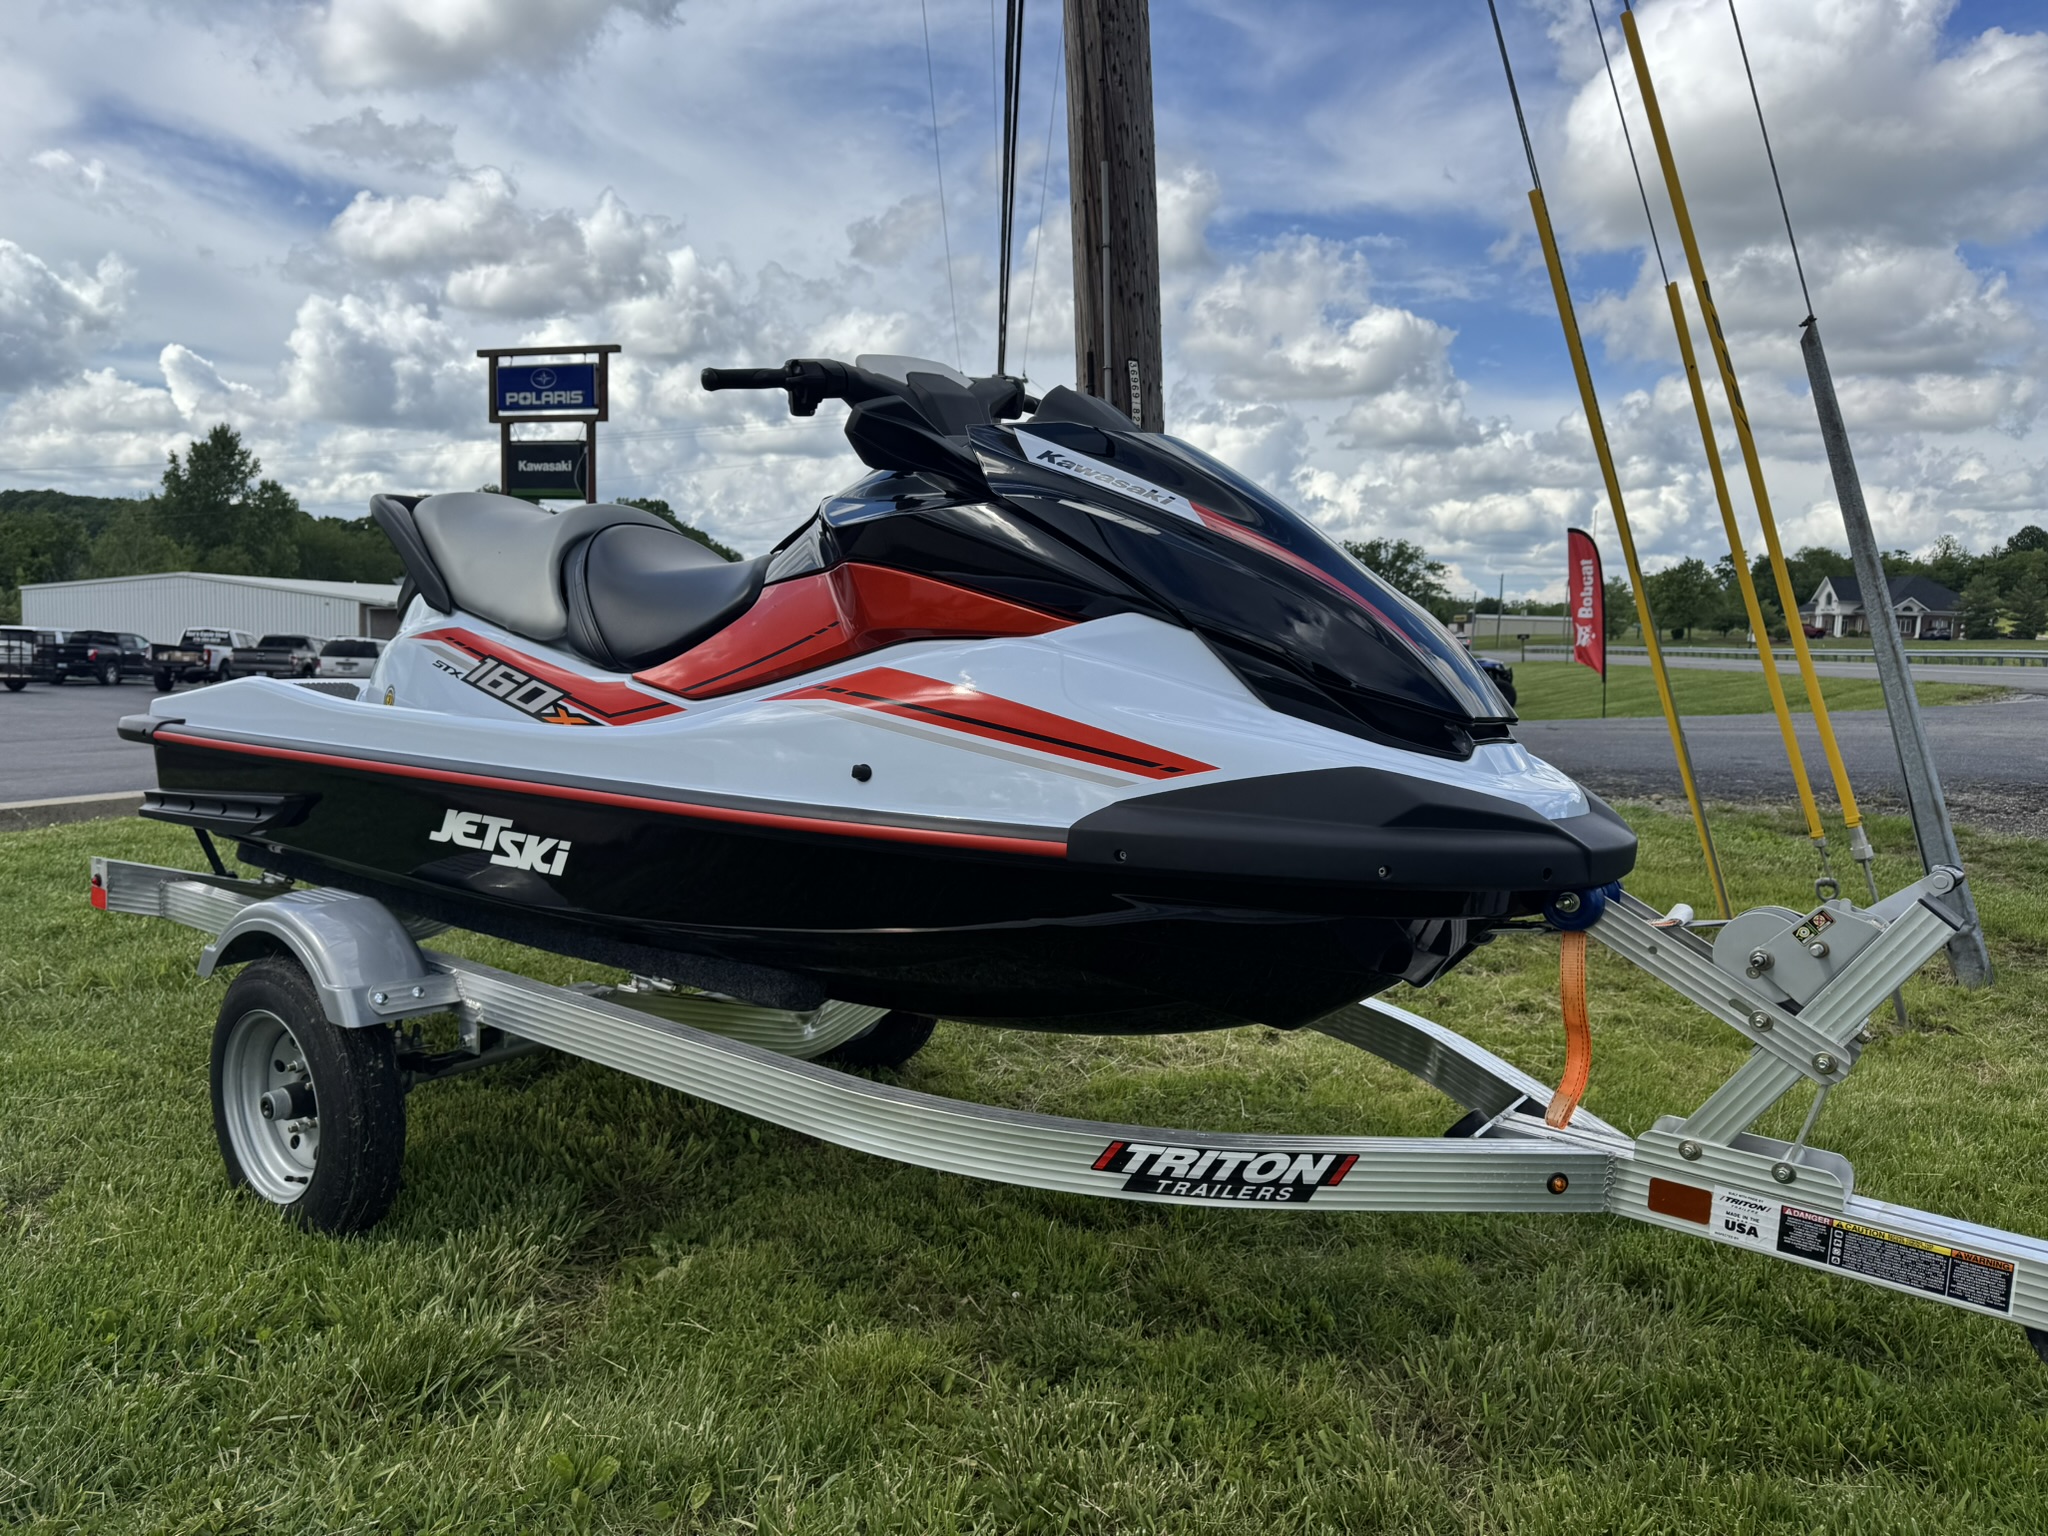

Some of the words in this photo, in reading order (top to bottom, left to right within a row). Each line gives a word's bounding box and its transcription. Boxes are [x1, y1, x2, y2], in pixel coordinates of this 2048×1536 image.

[505, 390, 583, 406] POLARIS
[518, 460, 572, 472] Kawasaki
[1036, 449, 1177, 506] Kawasaki
[1577, 558, 1594, 618] Bobcat
[431, 659, 464, 680] STX
[1121, 1143, 1337, 1185] TRITON
[1156, 1179, 1294, 1202] TRAILERS
[1724, 1196, 1767, 1212] TRITON
[1725, 1210, 1741, 1218] MADE
[1792, 1209, 1831, 1226] DANGER
[1724, 1219, 1759, 1238] USA
[1845, 1223, 1886, 1240] CAUTION
[1963, 1253, 2011, 1271] WARNING
